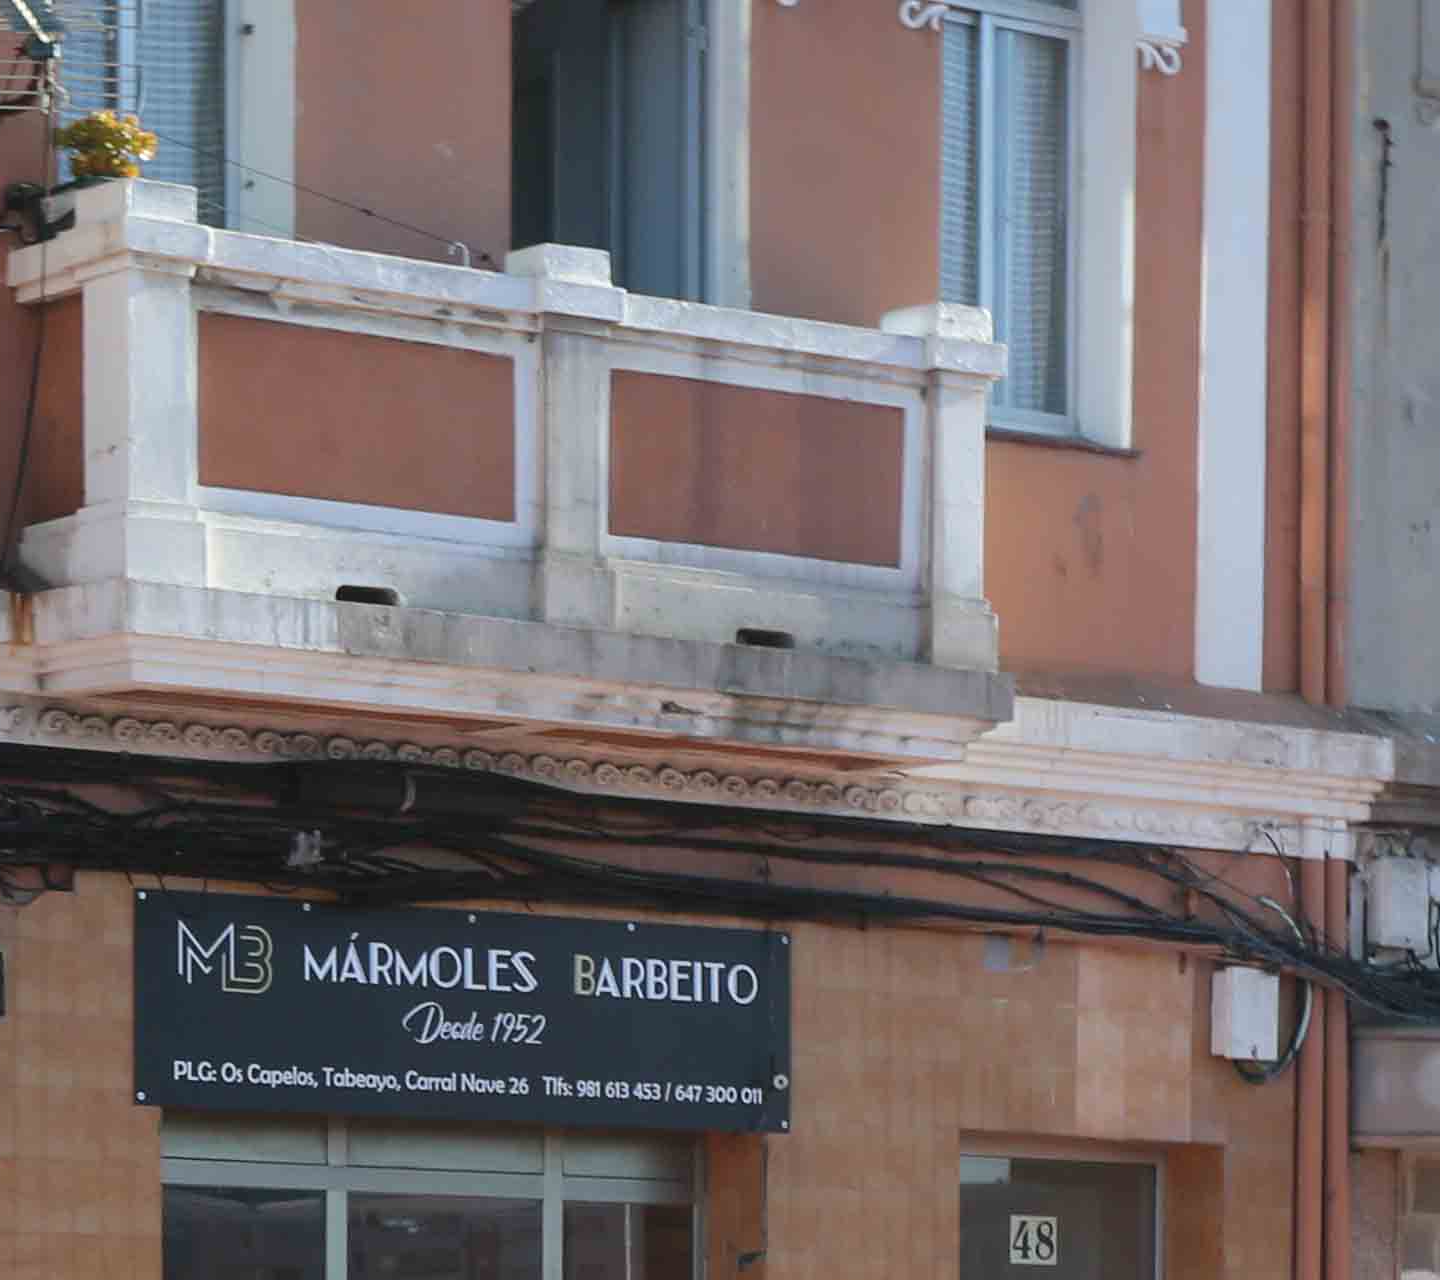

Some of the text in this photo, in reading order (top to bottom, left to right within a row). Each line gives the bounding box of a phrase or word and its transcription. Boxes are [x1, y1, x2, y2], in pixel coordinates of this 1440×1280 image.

[303, 932, 758, 1004] MÁRMOLES BARBEITO
[402, 1000, 546, 1046] Desde 1952
[221, 1065, 243, 1083] Os
[247, 1065, 319, 1088] Capelos,
[322, 1067, 401, 1092] Tabeayo,
[405, 1070, 456, 1091] Carral
[461, 1074, 505, 1094] Nave
[509, 1078, 529, 1095] 26
[576, 1081, 600, 1098] 981
[605, 1082, 628, 1098] 613
[633, 1083, 661, 1100] 453
[676, 1085, 701, 1102] 647
[706, 1086, 737, 1103] 300
[741, 1088, 762, 1104] 011
[1012, 1220, 1055, 1261] 48
